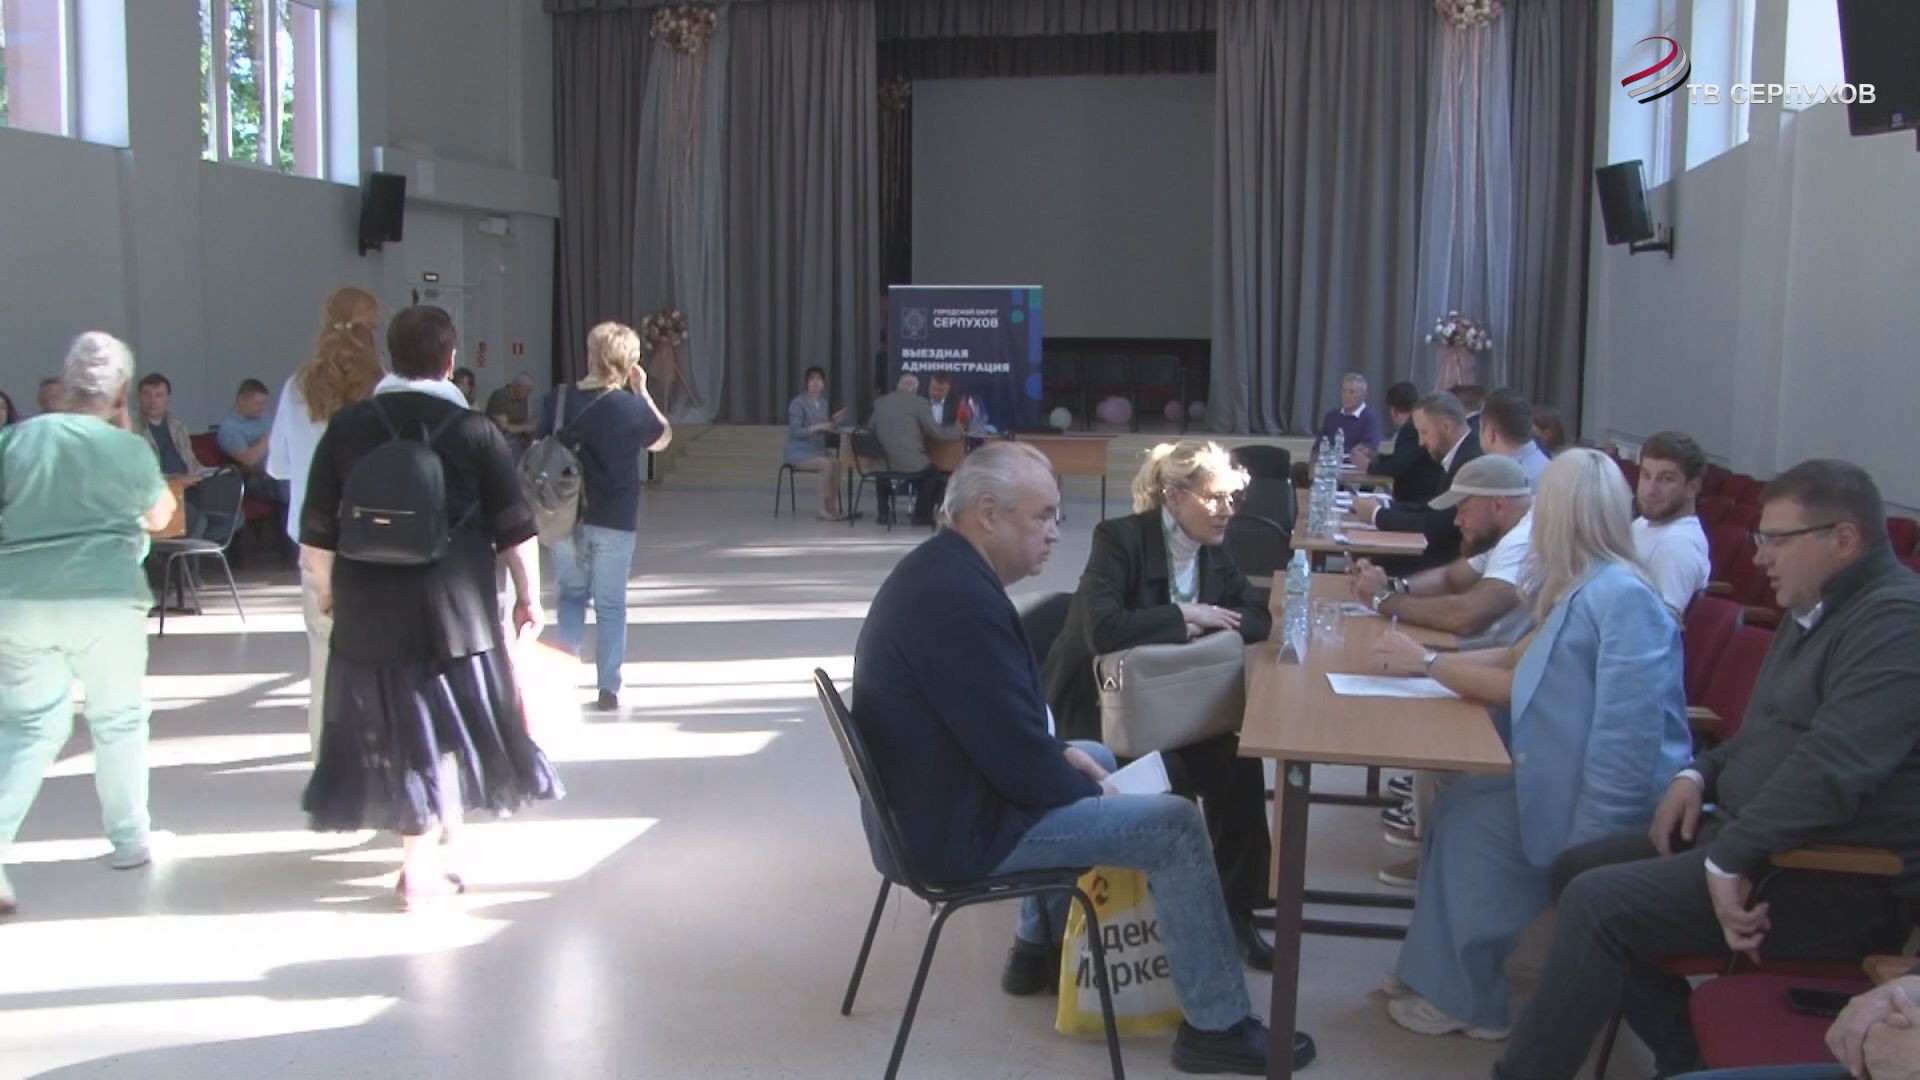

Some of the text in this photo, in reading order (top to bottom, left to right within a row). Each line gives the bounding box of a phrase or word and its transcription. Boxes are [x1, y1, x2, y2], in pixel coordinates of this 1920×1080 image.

[933, 317, 999, 328] СЕРПУХОВ
[902, 348, 969, 360] ВЫЕЗДНАЯ
[901, 361, 1010, 374] АДМИНИСТРАЦИЯ
